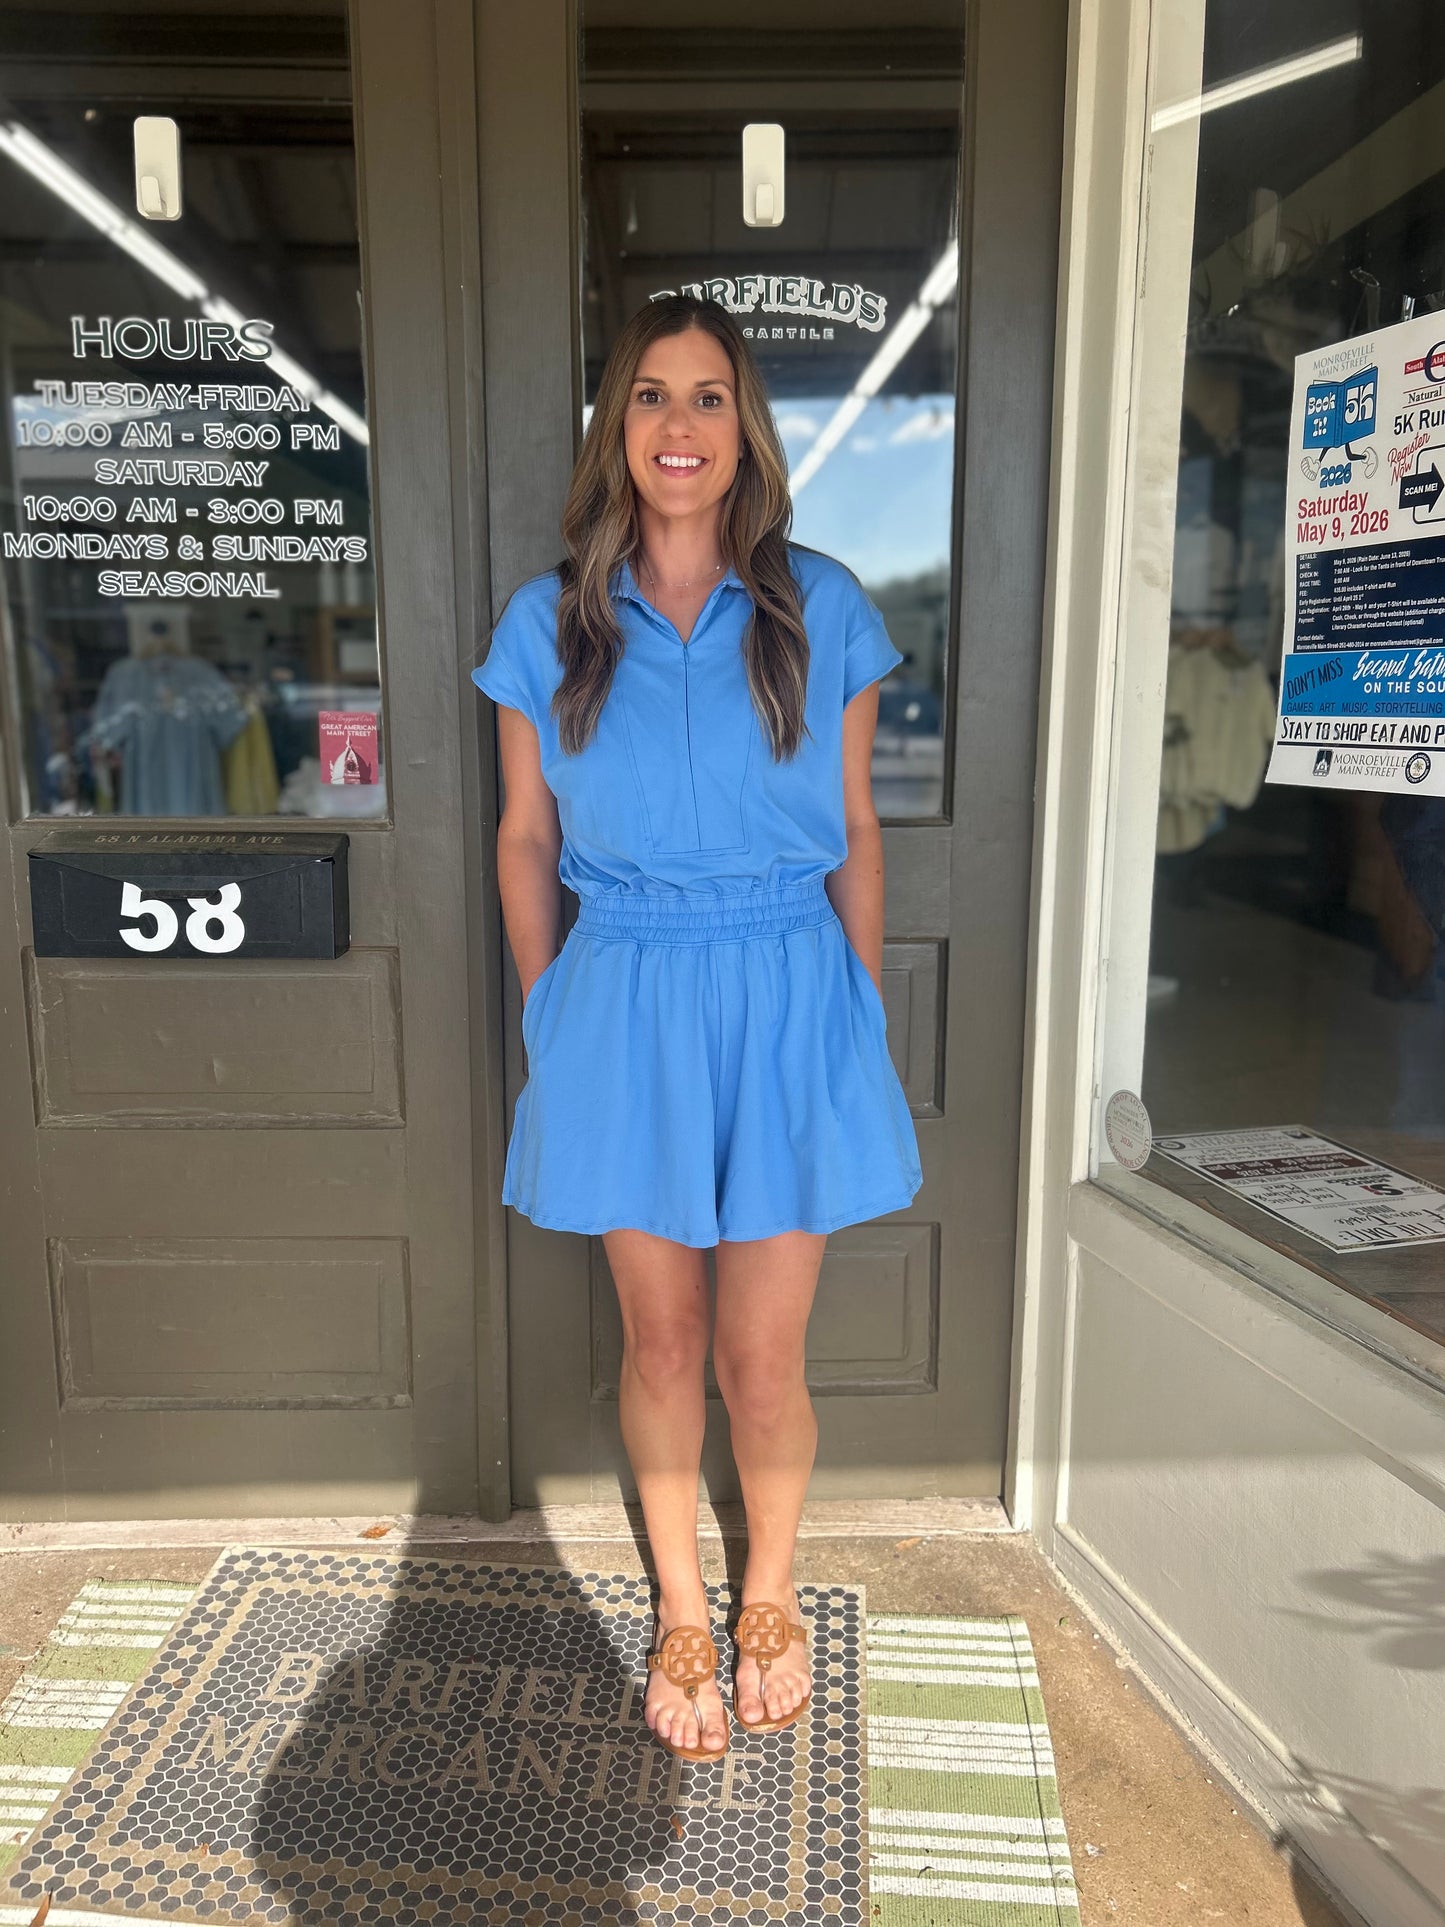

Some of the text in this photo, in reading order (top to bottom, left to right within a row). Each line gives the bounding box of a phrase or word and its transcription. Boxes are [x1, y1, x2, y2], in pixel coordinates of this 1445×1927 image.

[650, 274, 887, 332] RFIELD'S
[71, 316, 275, 361] HOURS
[743, 328, 835, 340] CANTILE
[1313, 343, 1375, 370] MONROEVILLE
[1318, 355, 1368, 378] MAIN STREET
[1406, 362, 1424, 372] South
[34, 379, 313, 411] TUESDAY-FRIDAY
[1344, 382, 1375, 424] 5K
[1408, 386, 1442, 404] Natural
[17, 420, 112, 447] 10:00
[121, 422, 173, 448] AM
[203, 423, 280, 449] 5:00
[291, 424, 340, 451] PM
[1394, 412, 1415, 436] 5K
[95, 459, 269, 487] SATURDAY
[1320, 462, 1352, 488] 2026
[1404, 483, 1438, 496] SCAN ME!
[24, 496, 117, 522] 10:00
[126, 498, 177, 523] AM
[207, 499, 285, 524] 3:00
[294, 500, 344, 525] PM
[1298, 490, 1369, 520] Saturday
[1297, 509, 1389, 546] May 9, 2026
[3, 533, 367, 562] MONDAYS & SUNDAYS
[1412, 558, 1436, 566] Downtown
[98, 570, 281, 599] SEASONAL
[1363, 611, 1380, 619] through
[1388, 609, 1404, 617] website
[1417, 597, 1437, 605] available
[1347, 622, 1366, 630] Character
[1386, 619, 1402, 627] Contest
[1403, 617, 1425, 626] (optional)
[1286, 657, 1343, 700] DON'T MISS
[1352, 651, 1409, 681] Second
[1363, 682, 1381, 693] ON
[1387, 682, 1410, 693] THE
[1287, 702, 1443, 714] GAMES ART MUSIC STORYTELLING
[1281, 716, 1312, 740] STAY
[1316, 722, 1331, 740] TO
[1333, 722, 1368, 741] SHOP
[1370, 723, 1397, 742] EAT
[1400, 724, 1431, 744] AND
[1334, 754, 1407, 768] MONROEVILLE
[1338, 765, 1398, 778] MAIN STREET
[94, 835, 285, 844] 58 N ALABAMA AVE
[118, 880, 246, 954] 58
[1339, 1227, 1398, 1242] DATE:
[1389, 1222, 1442, 1236] THE
[180, 1714, 768, 1810] MERCANTILE
